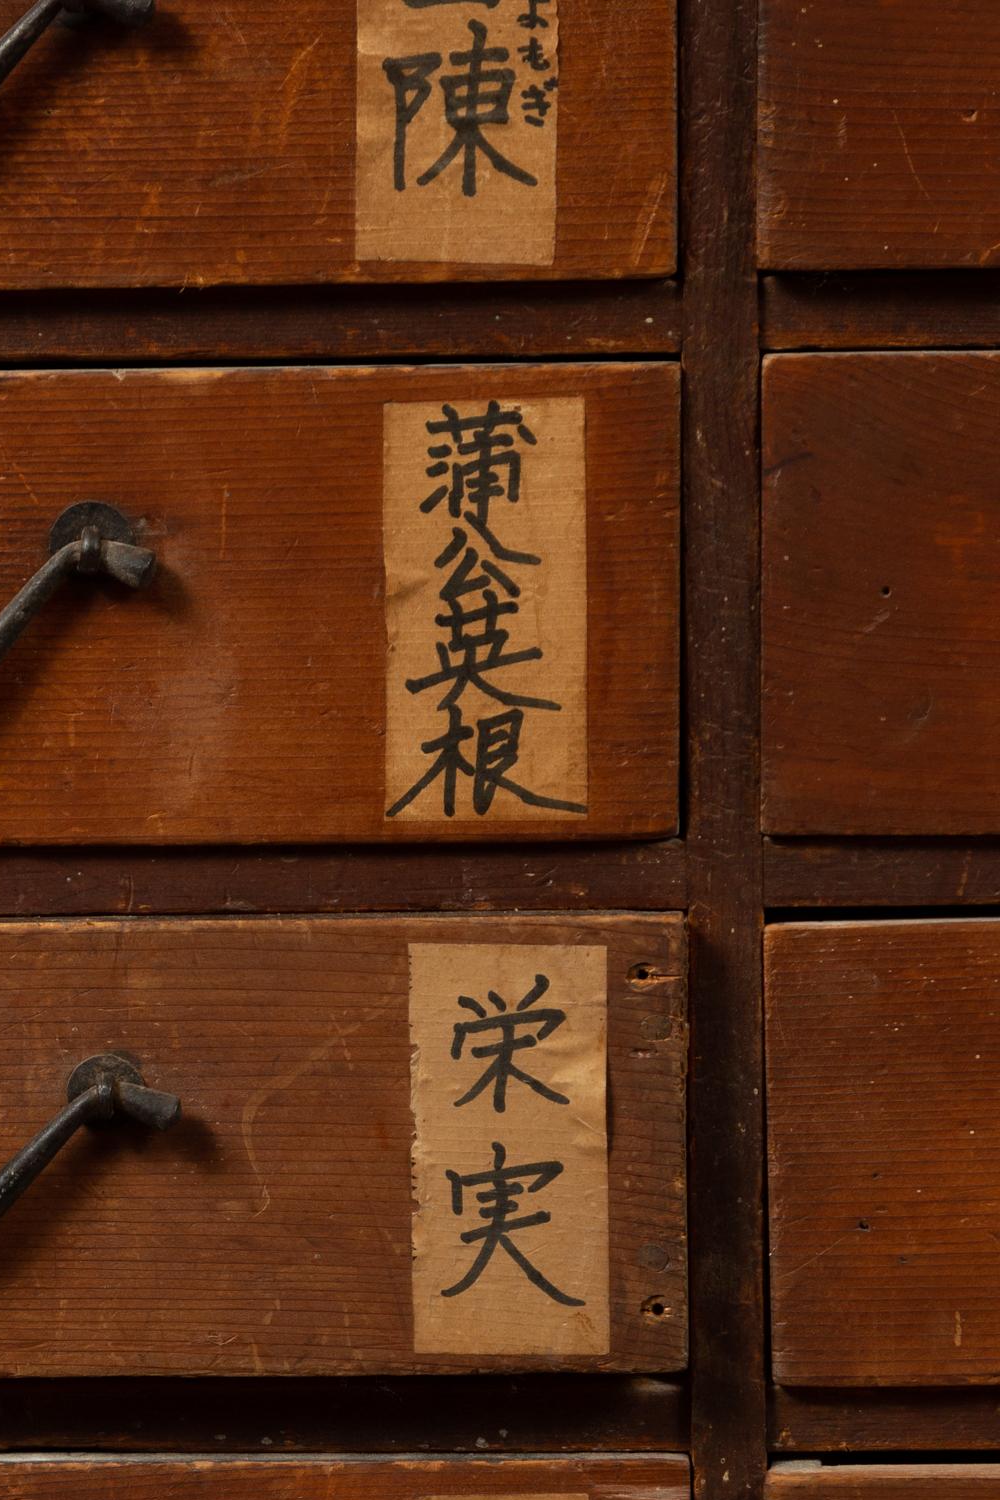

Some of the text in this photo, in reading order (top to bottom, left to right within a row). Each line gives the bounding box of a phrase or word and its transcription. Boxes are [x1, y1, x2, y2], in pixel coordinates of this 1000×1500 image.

[383, 0, 538, 197] 陳
[386, 400, 588, 818] 蒲公英根
[440, 974, 586, 1307] 栄実
